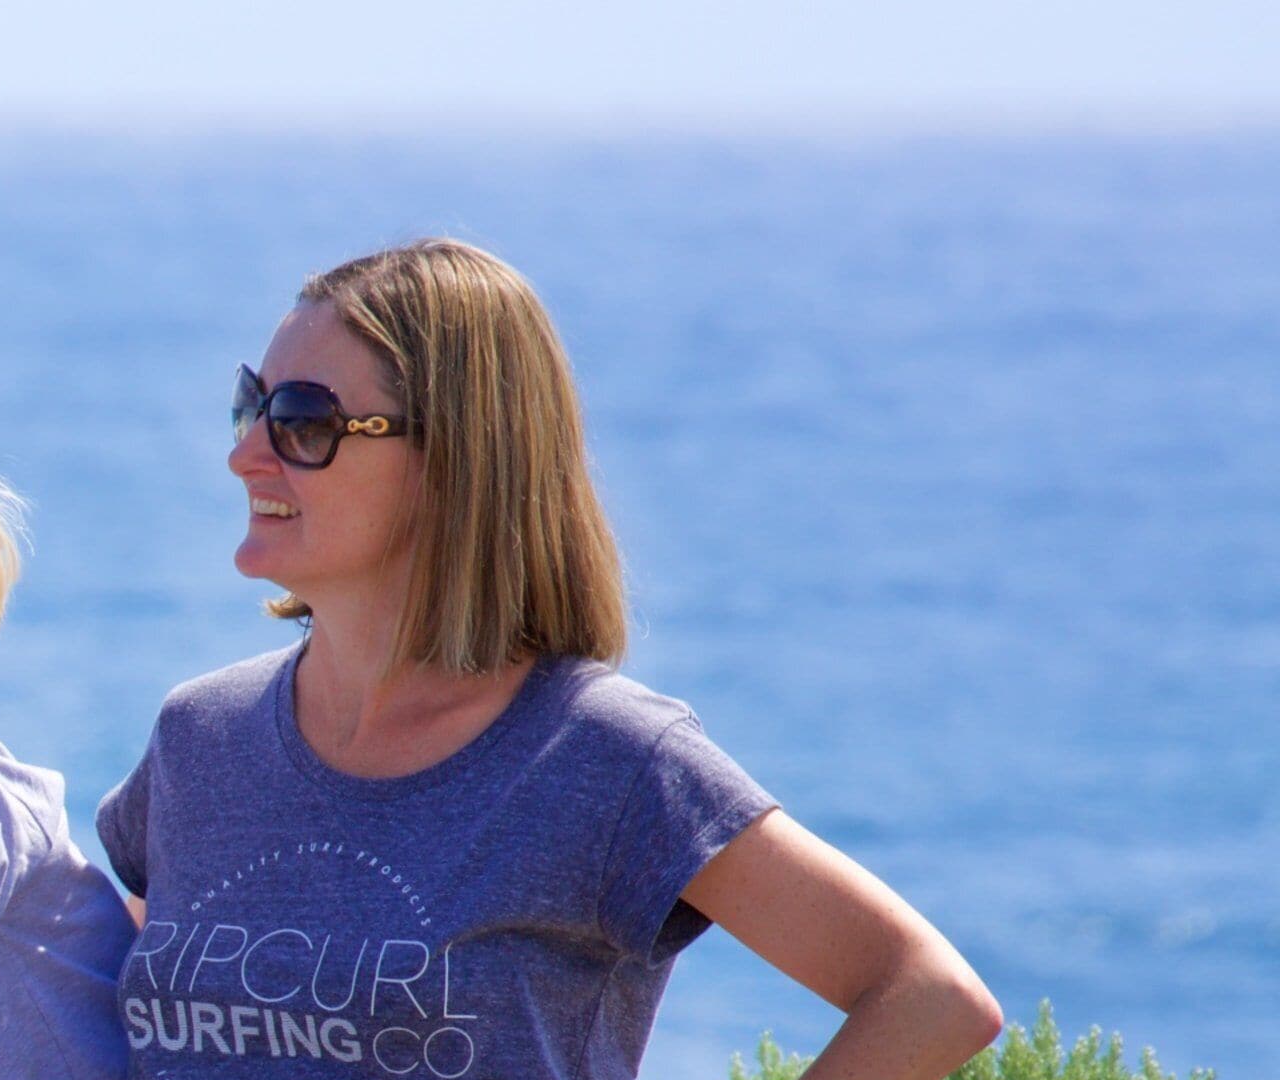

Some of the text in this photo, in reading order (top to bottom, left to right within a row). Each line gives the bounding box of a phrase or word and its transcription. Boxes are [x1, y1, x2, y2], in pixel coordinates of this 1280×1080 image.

[191, 842, 431, 927] QUALITY SURF PRODUCTS
[122, 920, 478, 1019] RIPCURL
[125, 997, 475, 1079] SURFING CO
